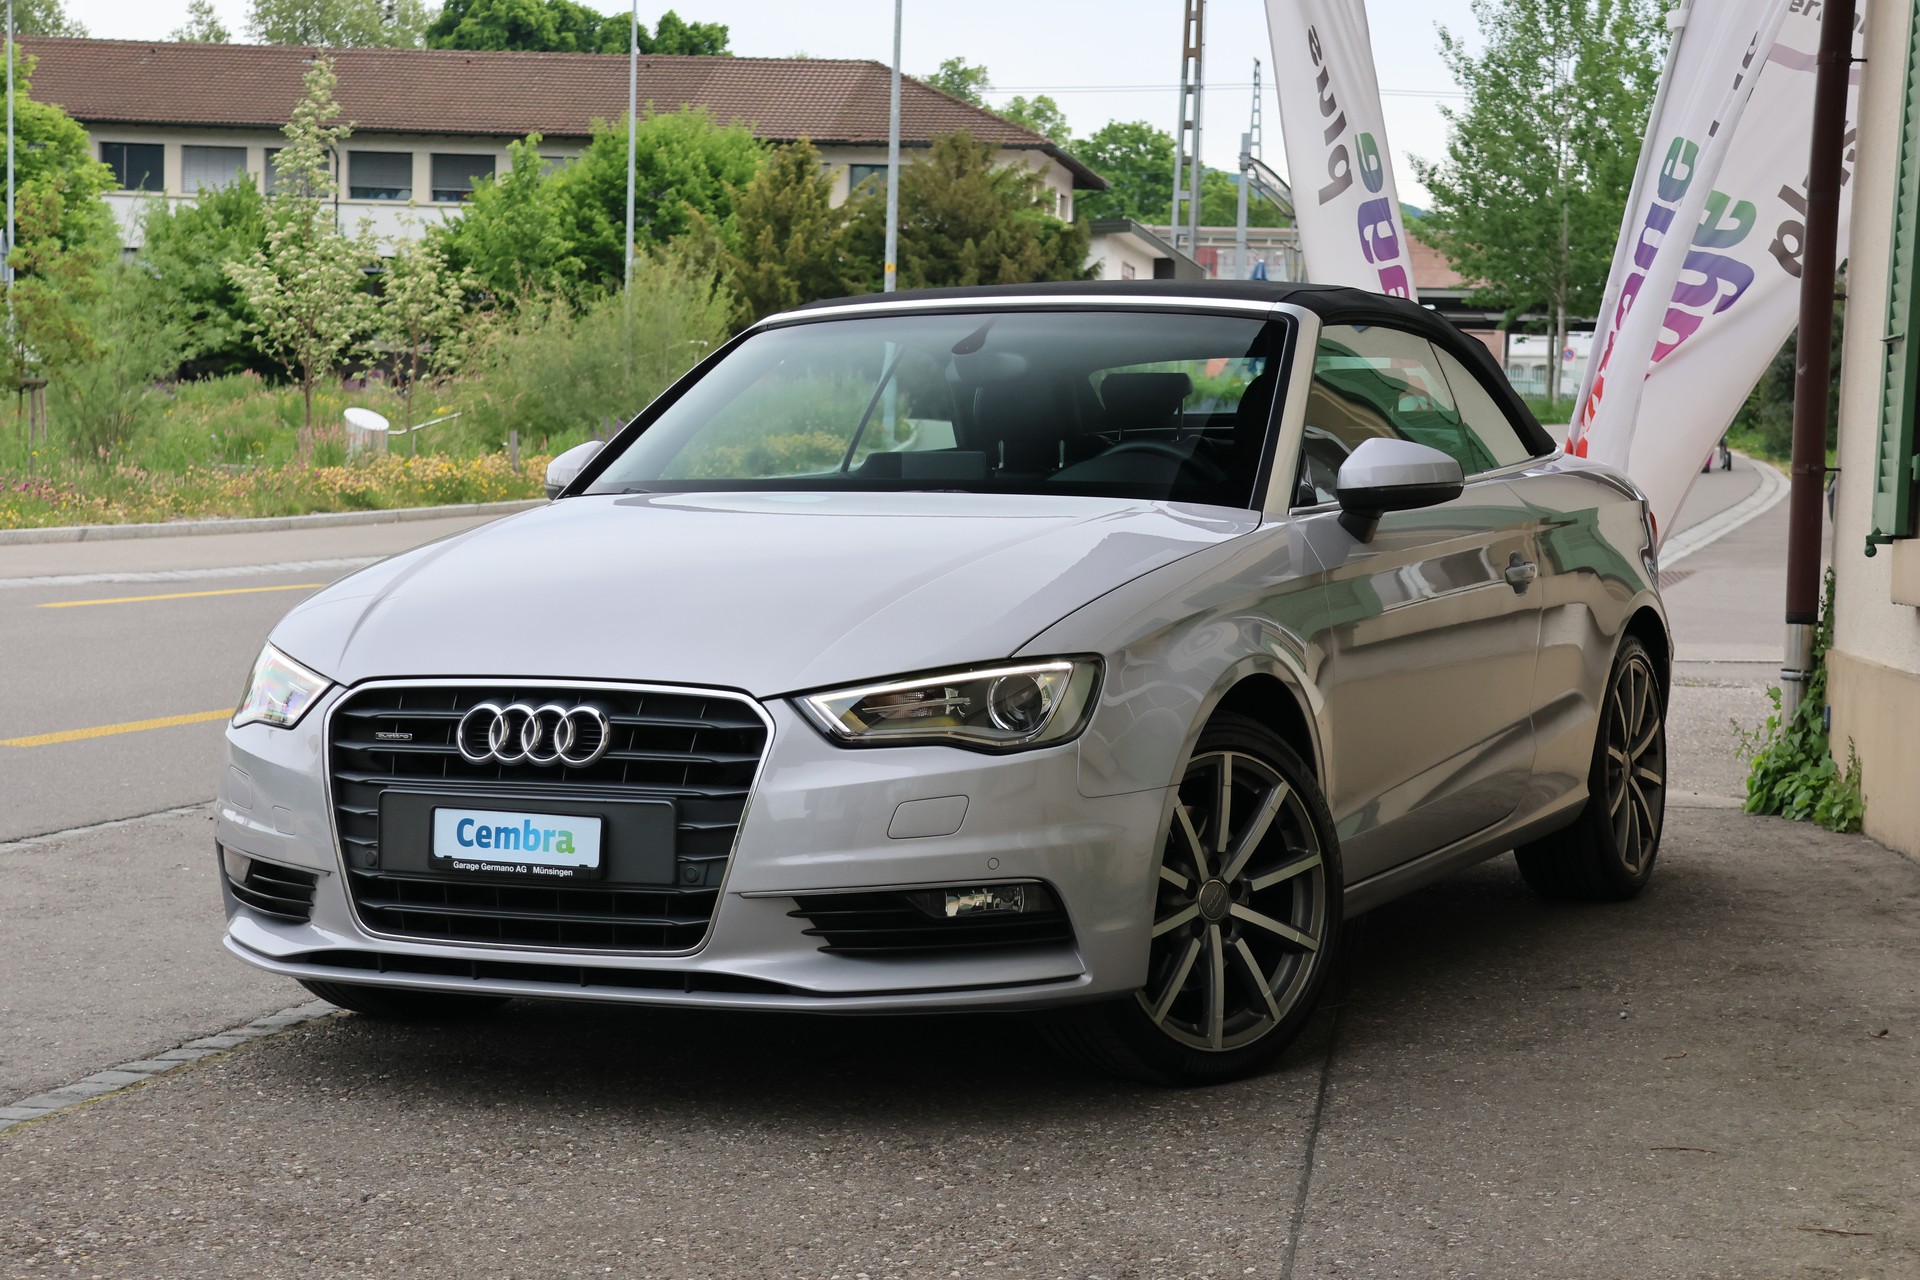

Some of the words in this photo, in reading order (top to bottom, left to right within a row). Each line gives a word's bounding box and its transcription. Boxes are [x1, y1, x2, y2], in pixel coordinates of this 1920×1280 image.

[456, 818, 576, 854] Cembra
[453, 861, 480, 872] Garage
[481, 863, 515, 873] Germano
[515, 865, 527, 873] AG
[533, 866, 573, 877] Münsingen
